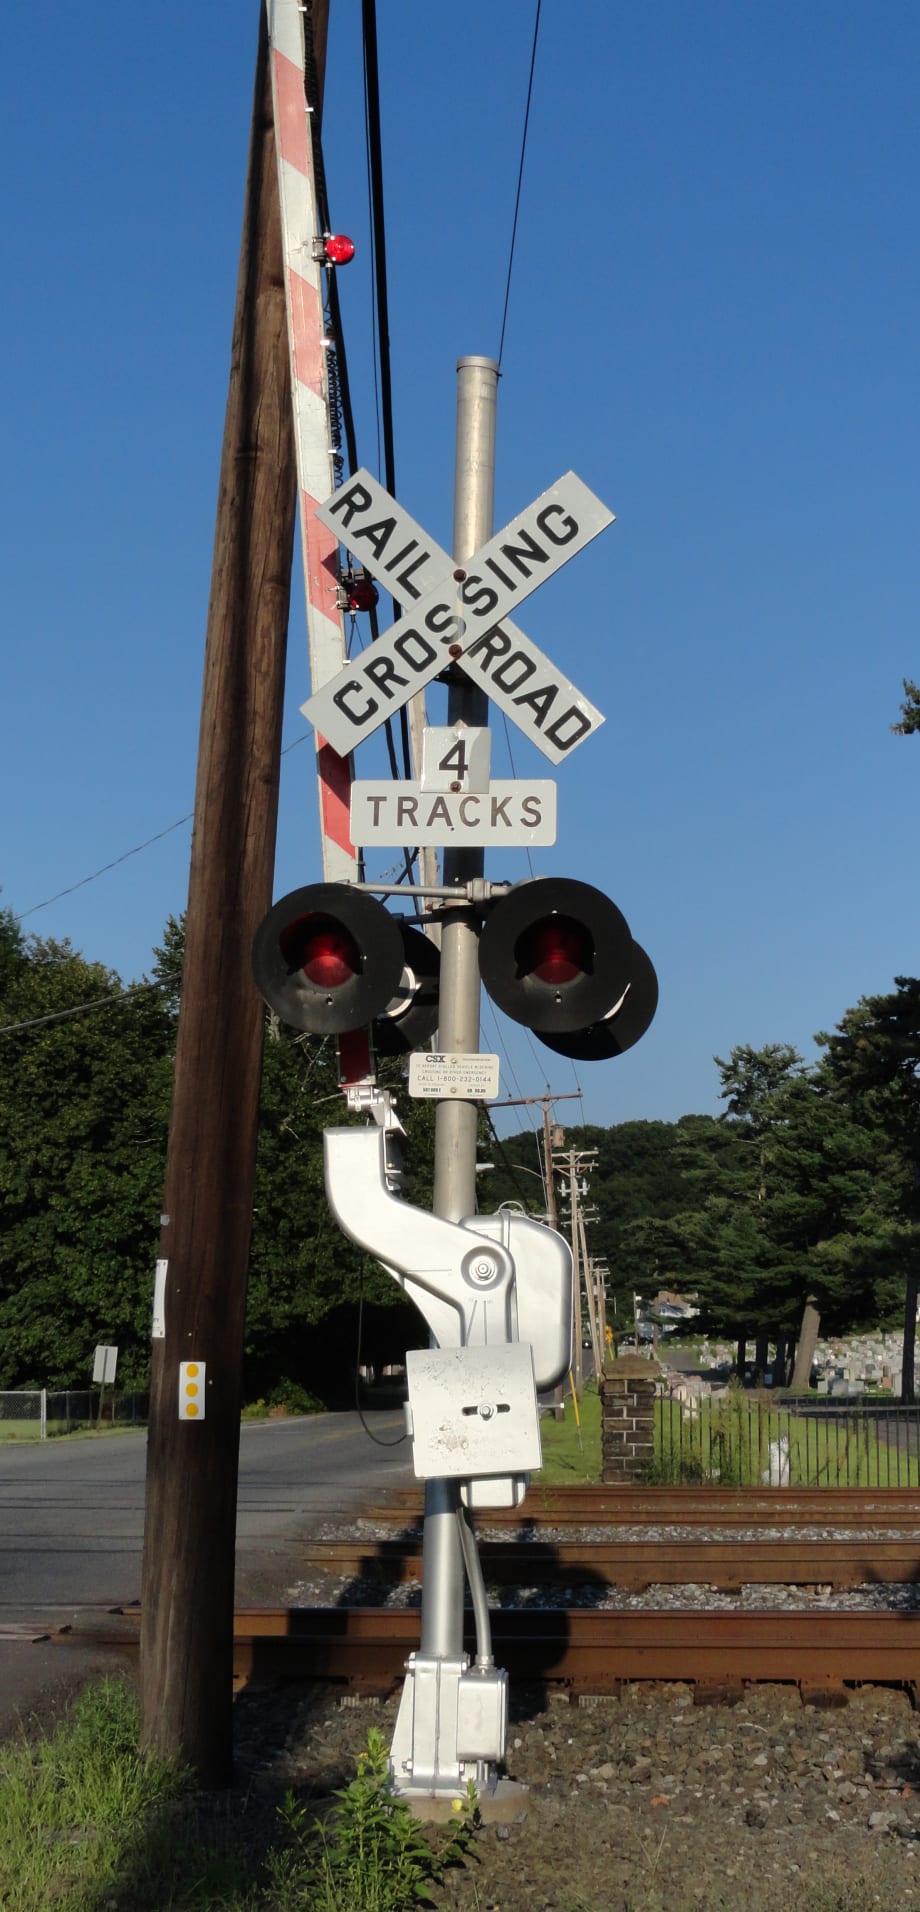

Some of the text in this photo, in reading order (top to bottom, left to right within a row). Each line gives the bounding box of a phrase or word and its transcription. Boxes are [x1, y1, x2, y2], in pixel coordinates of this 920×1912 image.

[329, 482, 592, 751] RAIL ROAD
[332, 504, 580, 727] CROSSING
[438, 739, 469, 781] 4
[366, 796, 542, 828] TRACKS
[425, 1055, 446, 1063] CSX
